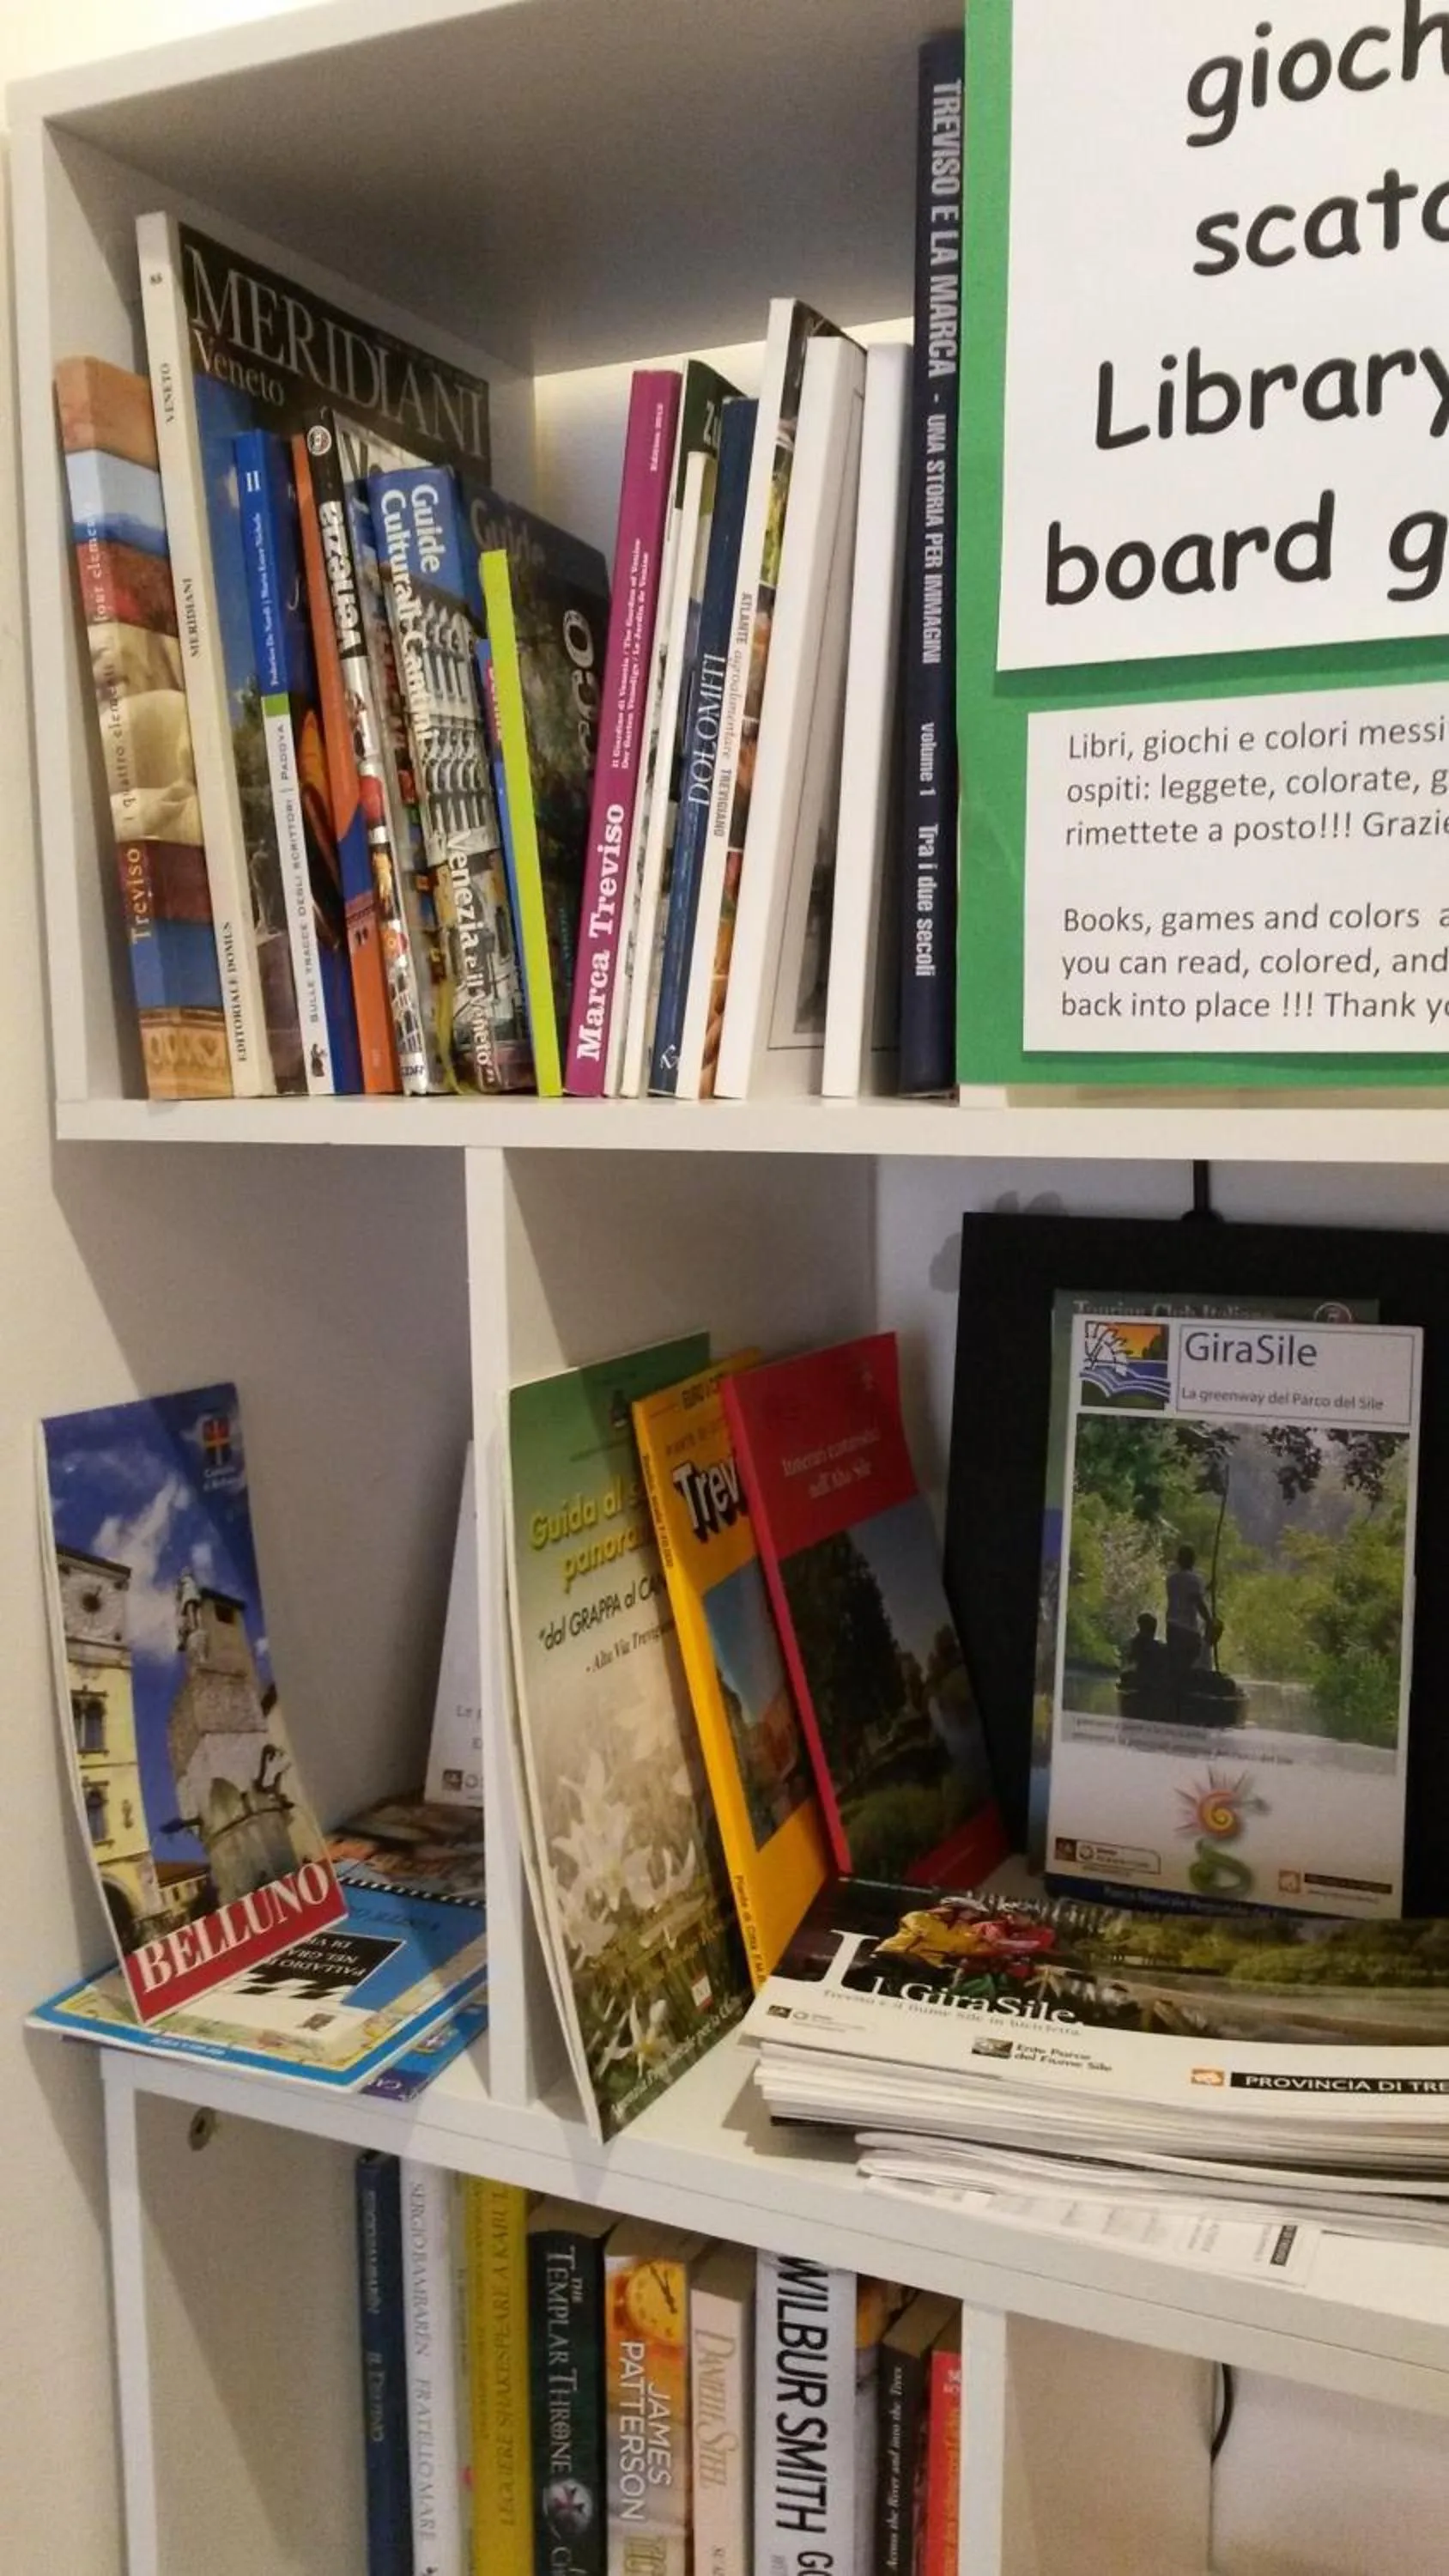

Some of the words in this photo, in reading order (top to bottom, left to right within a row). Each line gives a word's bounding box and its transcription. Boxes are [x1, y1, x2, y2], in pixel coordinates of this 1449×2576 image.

[1186, 0, 1449, 147] gioch
[931, 77, 962, 197] TREVISO
[930, 230, 959, 265] LA
[931, 205, 959, 223] E
[184, 244, 486, 459] MERIDIANI
[927, 274, 959, 379] MARCA
[161, 361, 175, 426] VENETO
[193, 327, 286, 407] Veneto
[926, 414, 947, 454] UNA
[411, 483, 446, 574] Guide
[925, 459, 946, 527] STORIA
[381, 489, 423, 622] Culturali
[924, 532, 944, 568] PER
[1046, 489, 1336, 605] board
[182, 578, 200, 659] MERIDIANI
[736, 590, 754, 646] ATLANTE
[922, 574, 943, 665] IMMAGINI
[277, 723, 290, 781] PADOVA
[688, 652, 727, 807] DOLOMITI
[919, 721, 937, 782] volume
[1068, 732, 1135, 761] Libri,
[1143, 726, 1229, 762] giochi
[1239, 732, 1256, 752] e
[1264, 720, 1348, 751] colori
[1359, 715, 1446, 745] messi
[713, 768, 733, 839] TREVIGIANO
[919, 787, 937, 797] 1
[1067, 775, 1151, 807] ospiti:
[1160, 771, 1276, 805] leggete,
[1286, 766, 1421, 795] colorate,
[284, 798, 300, 870] SCRITTORI
[918, 823, 939, 857] Tra
[1065, 818, 1199, 848] rimettete
[1208, 823, 1223, 842] a
[1234, 812, 1352, 848] posto!!!
[125, 847, 152, 945] Treviso
[446, 828, 482, 950] Venezia
[589, 803, 626, 939] Treviso
[917, 875, 938, 912] due
[915, 917, 936, 978] secoli
[1063, 906, 1152, 935] Books,
[1161, 908, 1255, 938] games
[1264, 902, 1319, 930] and
[1329, 902, 1421, 929] colors
[466, 972, 484, 986] il
[1062, 952, 1112, 981] you
[1119, 952, 1167, 975] can
[1177, 947, 1250, 979] read,
[1259, 946, 1381, 978] colored,
[1391, 945, 1449, 974] and
[227, 977, 247, 1063] EDITORIALE
[304, 978, 319, 1024] SULLE
[470, 992, 492, 1066] Veneto
[576, 948, 611, 1062] Marca
[1062, 991, 1123, 1018] back
[1131, 991, 1187, 1018] into
[1195, 991, 1270, 1024] place
[1282, 991, 1315, 1018] !!!
[1325, 990, 1417, 1018] Thank
[1184, 1331, 1319, 1368] GiraSile
[1181, 1386, 1197, 1401] La
[1198, 1388, 1266, 1406] greenway
[1268, 1390, 1288, 1406] del
[1291, 1392, 1331, 1408] Parco
[1335, 1394, 1356, 1410] del
[1359, 1397, 1385, 1412] Sile
[528, 1495, 600, 1552] Guida
[603, 1475, 624, 1521] al
[568, 1594, 621, 1639] GRAPPA
[623, 1580, 637, 1608] al
[131, 1861, 331, 1995] BELLUNO
[1245, 2074, 1372, 2093] PROVINCIA
[1378, 2078, 1402, 2093] DI
[545, 2245, 577, 2365] TEMPLAR
[775, 2255, 830, 2409] WILBUR
[493, 2284, 513, 2428] SHAKESPEARE
[548, 2367, 578, 2474] THRONE
[619, 2340, 646, 2523] PATTERSON
[646, 2383, 672, 2488] JAMES
[775, 2411, 830, 2535] SMITH
